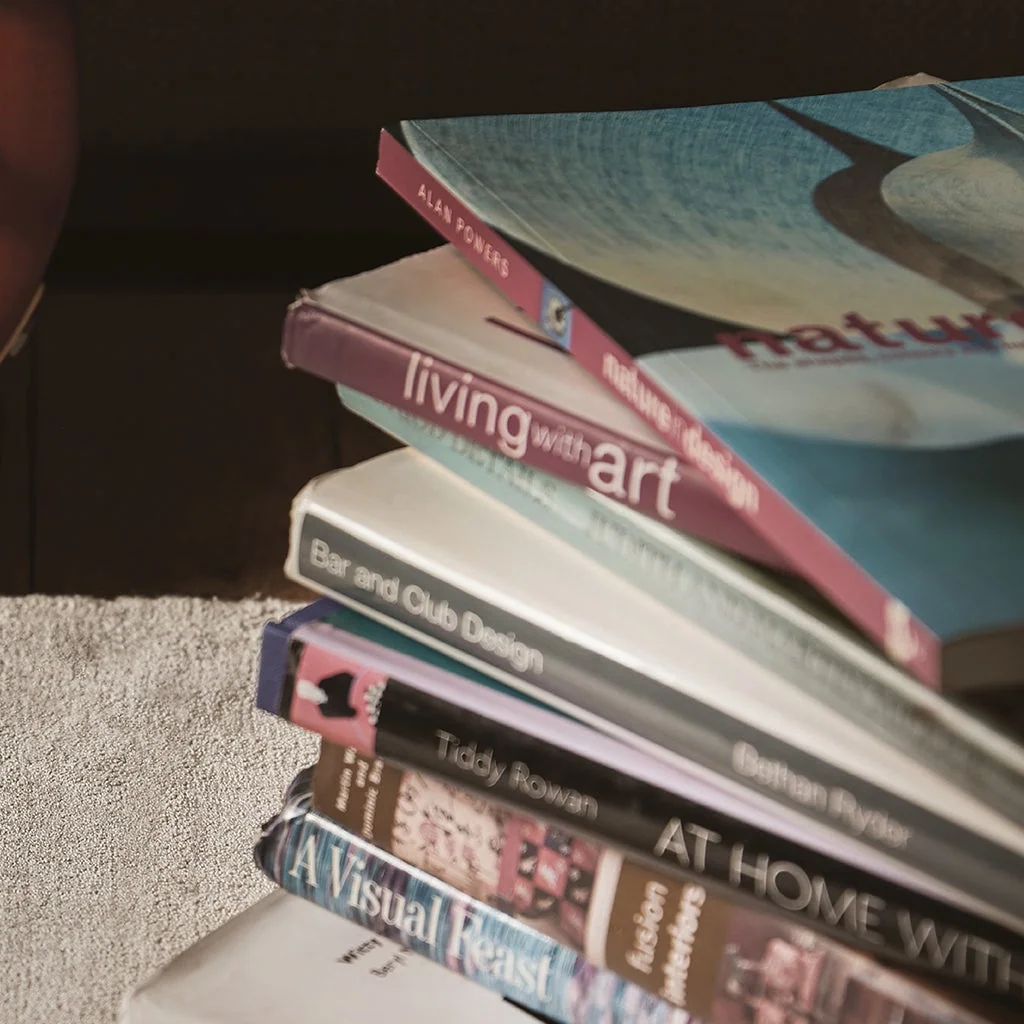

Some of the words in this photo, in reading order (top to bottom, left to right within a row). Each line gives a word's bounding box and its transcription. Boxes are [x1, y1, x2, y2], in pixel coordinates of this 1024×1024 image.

[417, 184, 453, 224] ALAN
[455, 217, 510, 278] POWERS
[403, 351, 532, 459] living
[530, 421, 593, 470] with
[587, 442, 682, 521] art
[602, 352, 672, 434] nature
[310, 537, 352, 579] Bar
[353, 565, 401, 605] and
[402, 584, 459, 633] Club
[460, 611, 545, 676] Design
[435, 728, 508, 789] Tiddy
[508, 760, 600, 821] Rowan
[288, 833, 319, 889] A
[329, 842, 444, 949] Visual
[448, 898, 555, 1004] Feast
[625, 880, 669, 976] fusion
[658, 882, 708, 1007] interiors
[652, 816, 724, 874] AT
[728, 842, 888, 948] HOME
